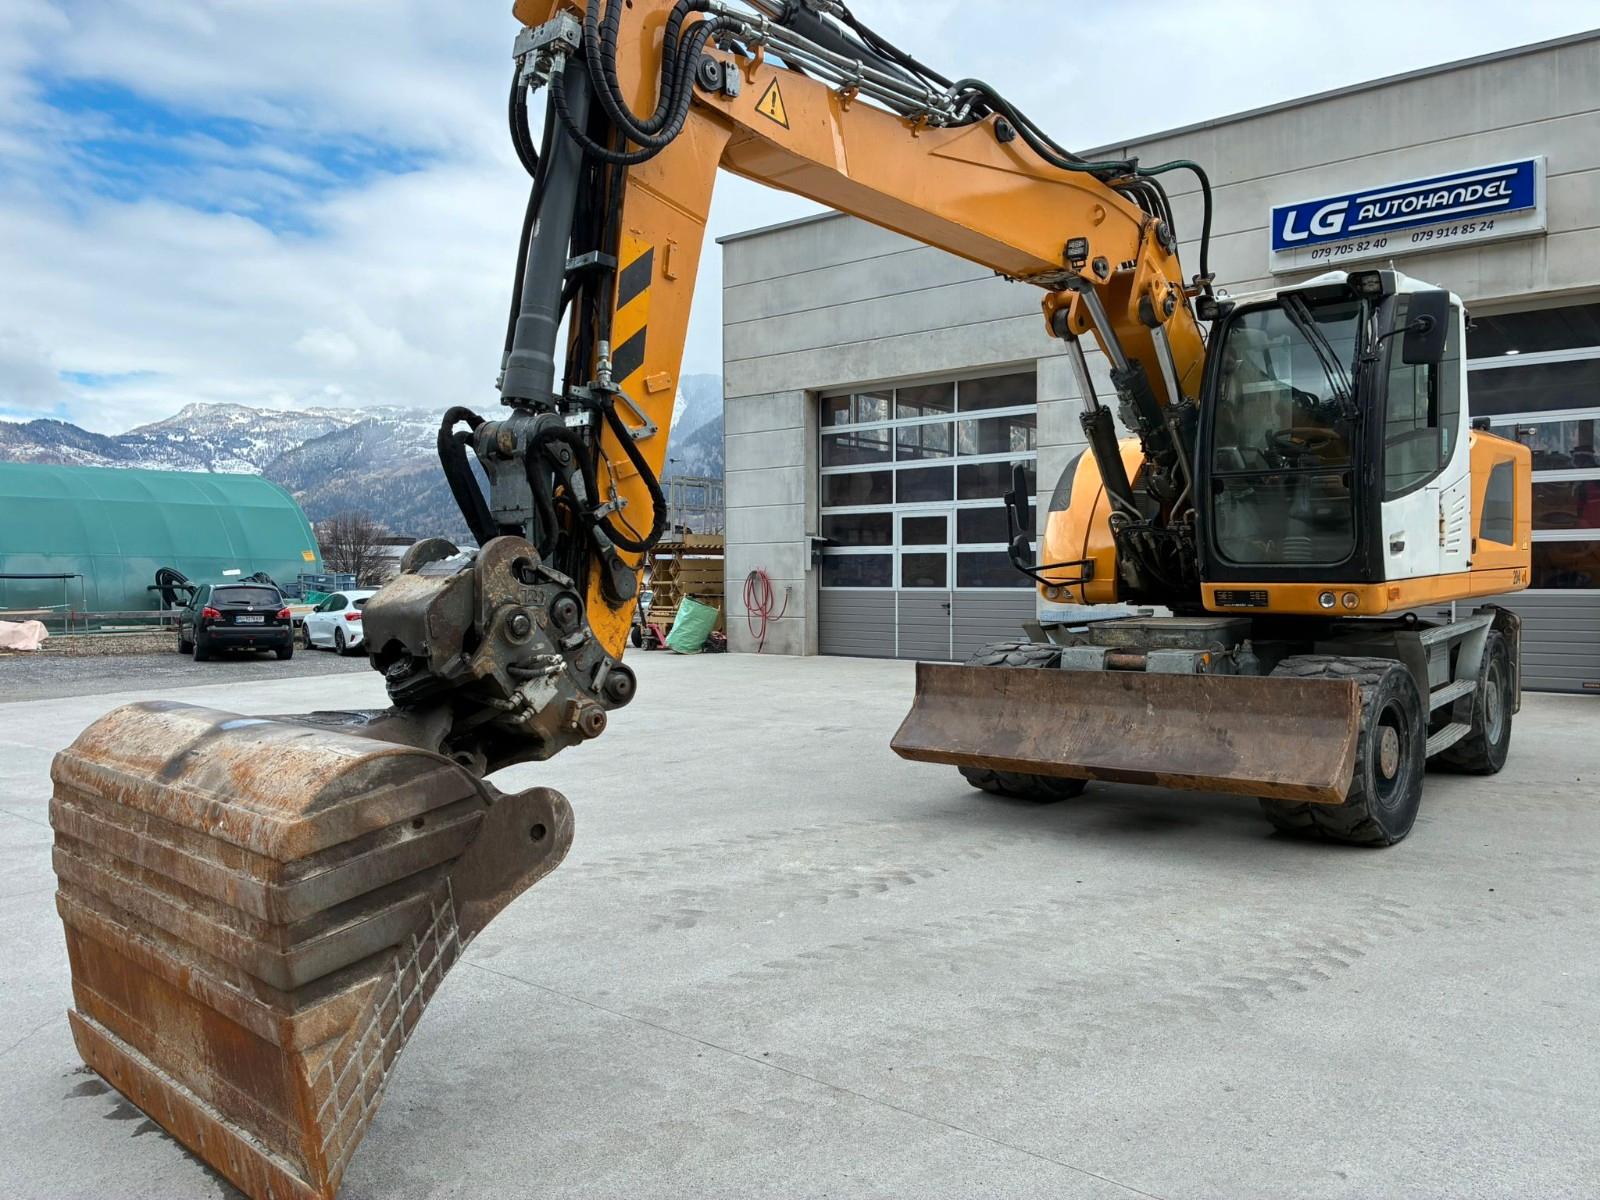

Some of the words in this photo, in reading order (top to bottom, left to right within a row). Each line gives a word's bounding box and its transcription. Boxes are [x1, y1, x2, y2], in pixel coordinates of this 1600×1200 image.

[1282, 201, 1349, 241] LG
[1358, 179, 1512, 221] AUTOHANDEL
[1411, 230, 1433, 243] 079
[1436, 226, 1458, 239] 914
[1461, 222, 1476, 235] 85
[1478, 219, 1494, 232] 24
[1311, 247, 1331, 260] 079
[1334, 243, 1354, 256] 705
[1356, 240, 1370, 252] 82
[1373, 237, 1387, 249] 40
